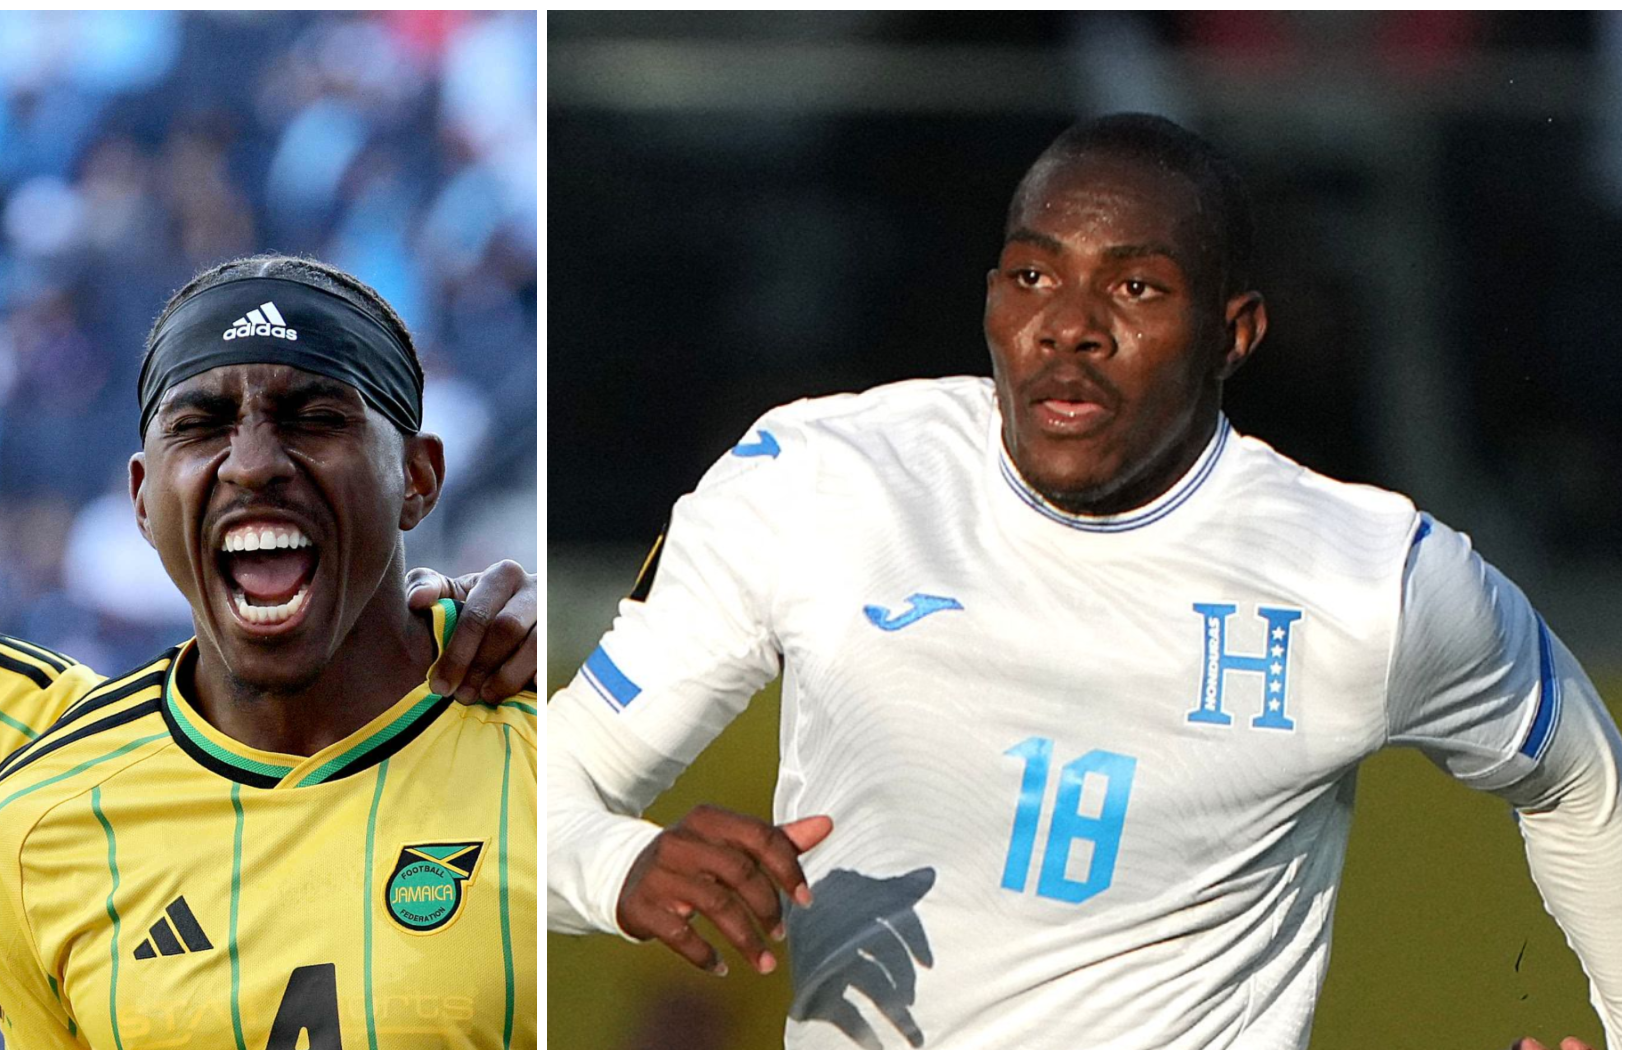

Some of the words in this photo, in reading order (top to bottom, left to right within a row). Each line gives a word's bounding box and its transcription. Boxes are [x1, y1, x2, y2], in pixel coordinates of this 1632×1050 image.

[222, 322, 298, 341] adidas
[1186, 602, 1303, 732] H
[1204, 616, 1221, 712] HONDURAS
[1000, 735, 1138, 905] 18
[400, 865, 445, 880] FOOTBALL
[391, 884, 454, 904] JAMAICA
[399, 906, 446, 922] FEDERATION
